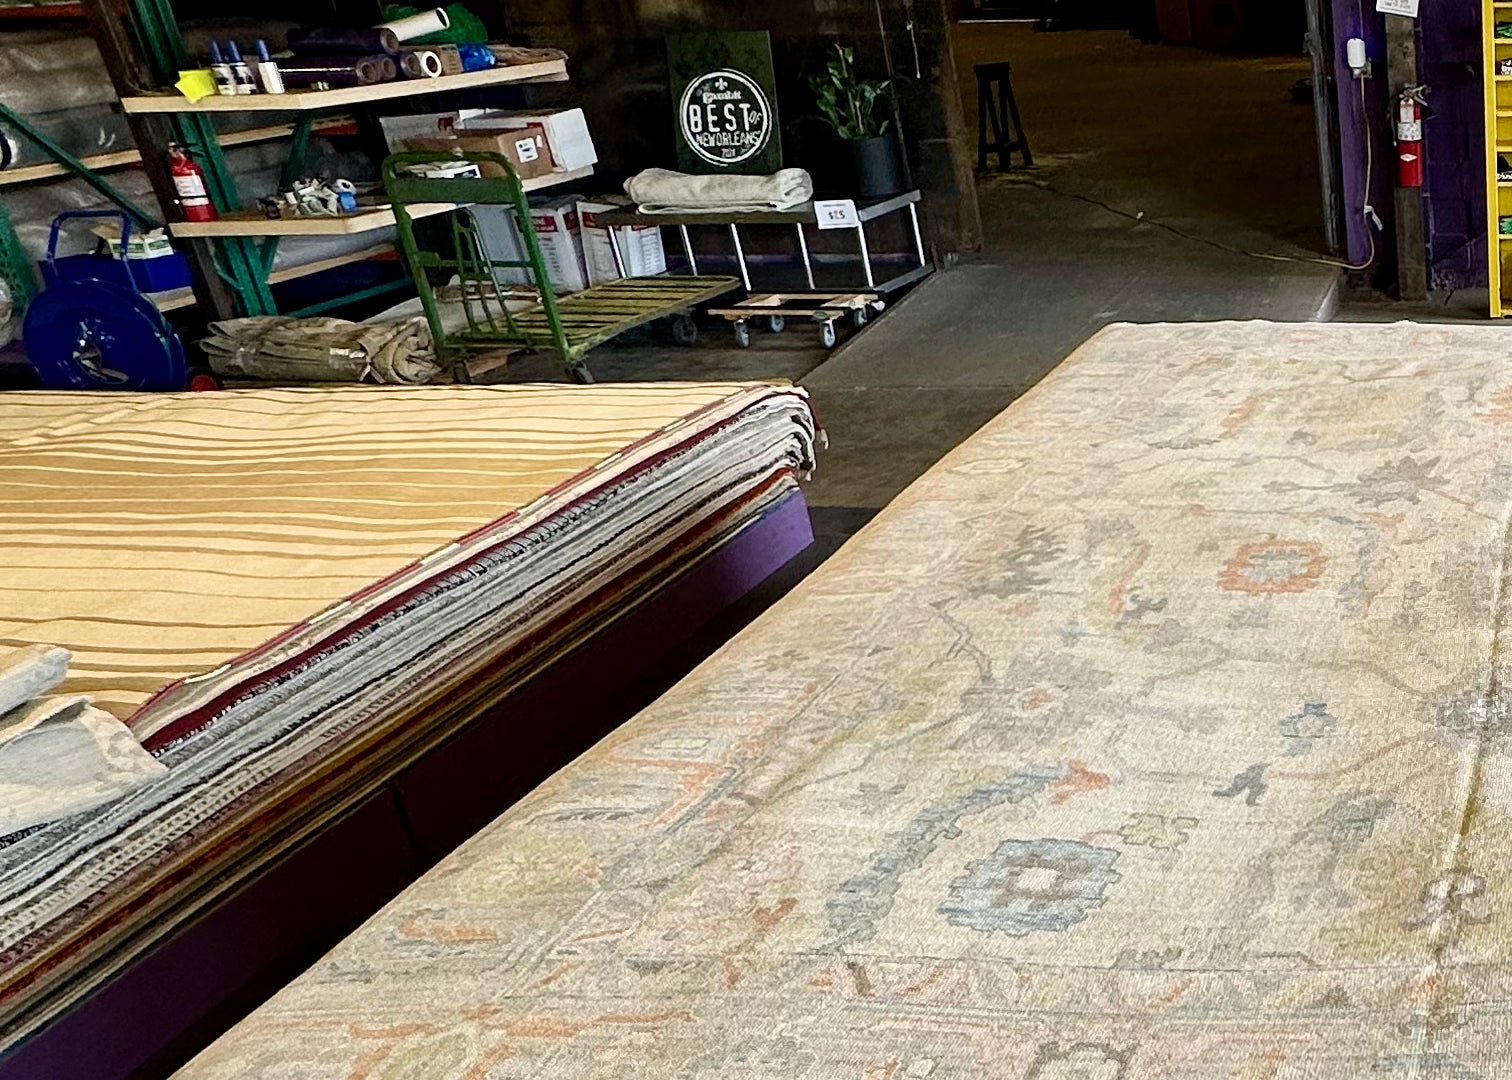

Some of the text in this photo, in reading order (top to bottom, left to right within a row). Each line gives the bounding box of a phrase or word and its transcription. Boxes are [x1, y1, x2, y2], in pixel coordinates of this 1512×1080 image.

[689, 103, 763, 132] BEST OF
[696, 130, 761, 147] NEW ORLEANS
